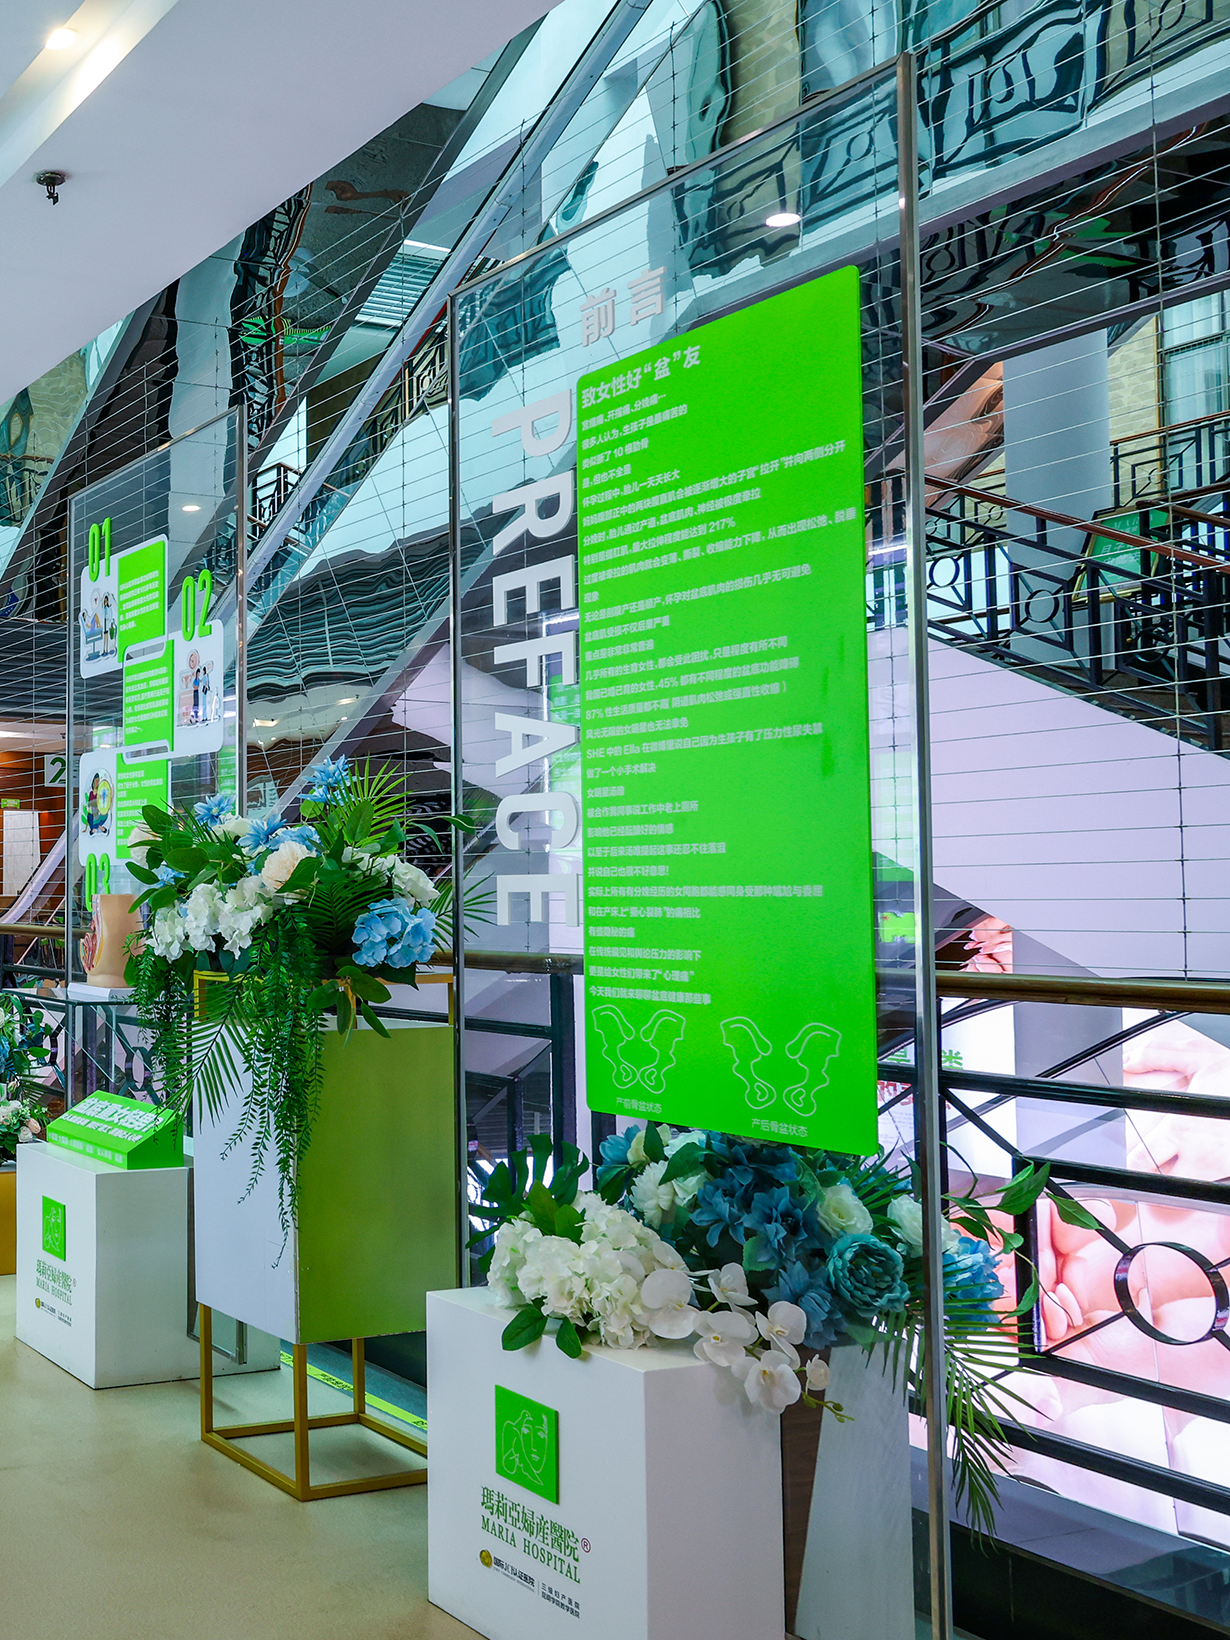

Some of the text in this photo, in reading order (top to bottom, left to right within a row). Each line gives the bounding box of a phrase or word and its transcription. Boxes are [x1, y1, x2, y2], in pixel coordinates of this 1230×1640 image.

[580, 266, 667, 347] 前言
[581, 449, 612, 470] 类似断了
[612, 445, 624, 458] 10
[708, 515, 736, 533] 217%
[88, 517, 112, 582] 01
[182, 569, 212, 641] 02
[583, 590, 599, 603] 现象
[492, 388, 581, 927] PREFACE
[585, 708, 603, 720] 87%
[585, 747, 605, 759] SHE
[606, 745, 622, 756] 中的
[623, 743, 640, 754] Ella
[481, 1515, 517, 1549] MARIA
[523, 1538, 581, 1585] HOSPITAL
